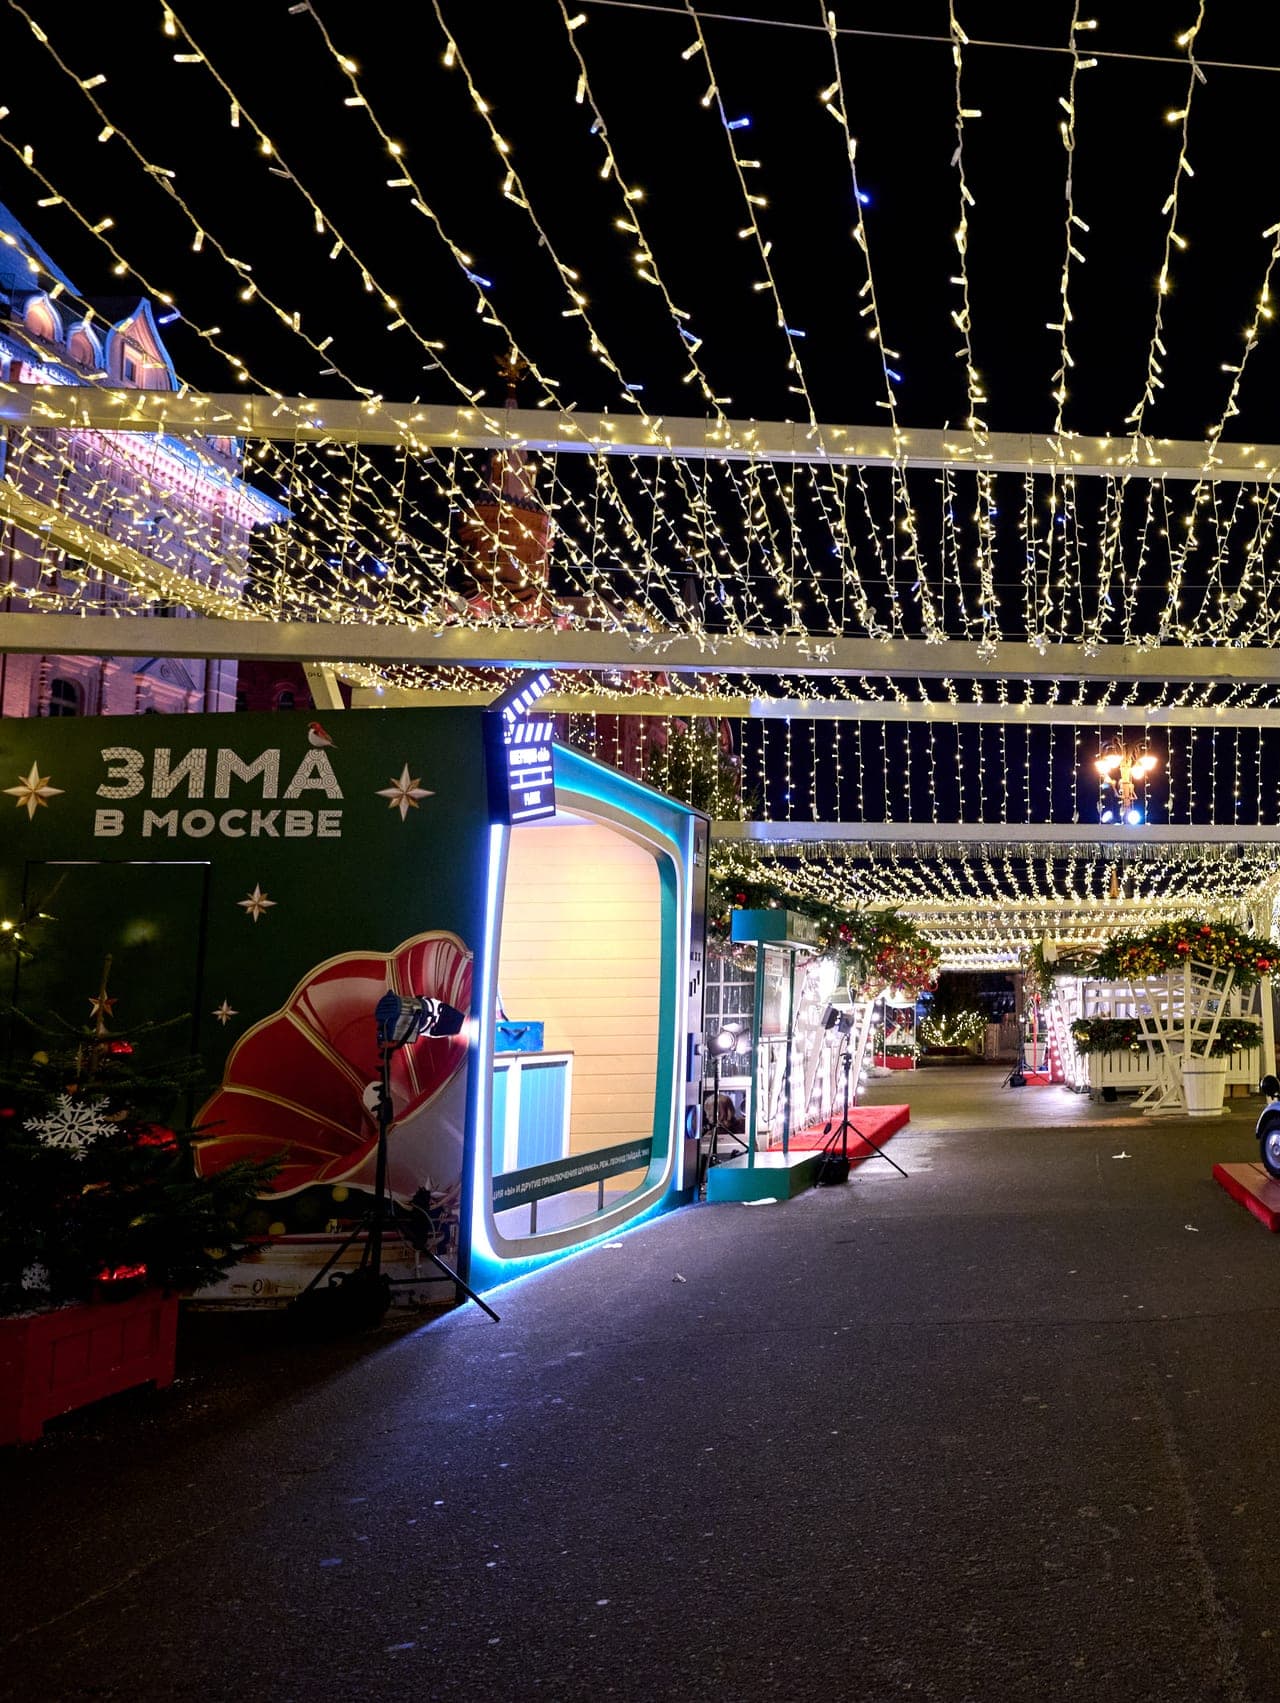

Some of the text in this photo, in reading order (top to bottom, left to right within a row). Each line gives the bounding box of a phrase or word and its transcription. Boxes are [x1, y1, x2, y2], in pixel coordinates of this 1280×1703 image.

[96, 747, 344, 799] ЗИМА
[94, 809, 343, 837] В МОСКВЕ
